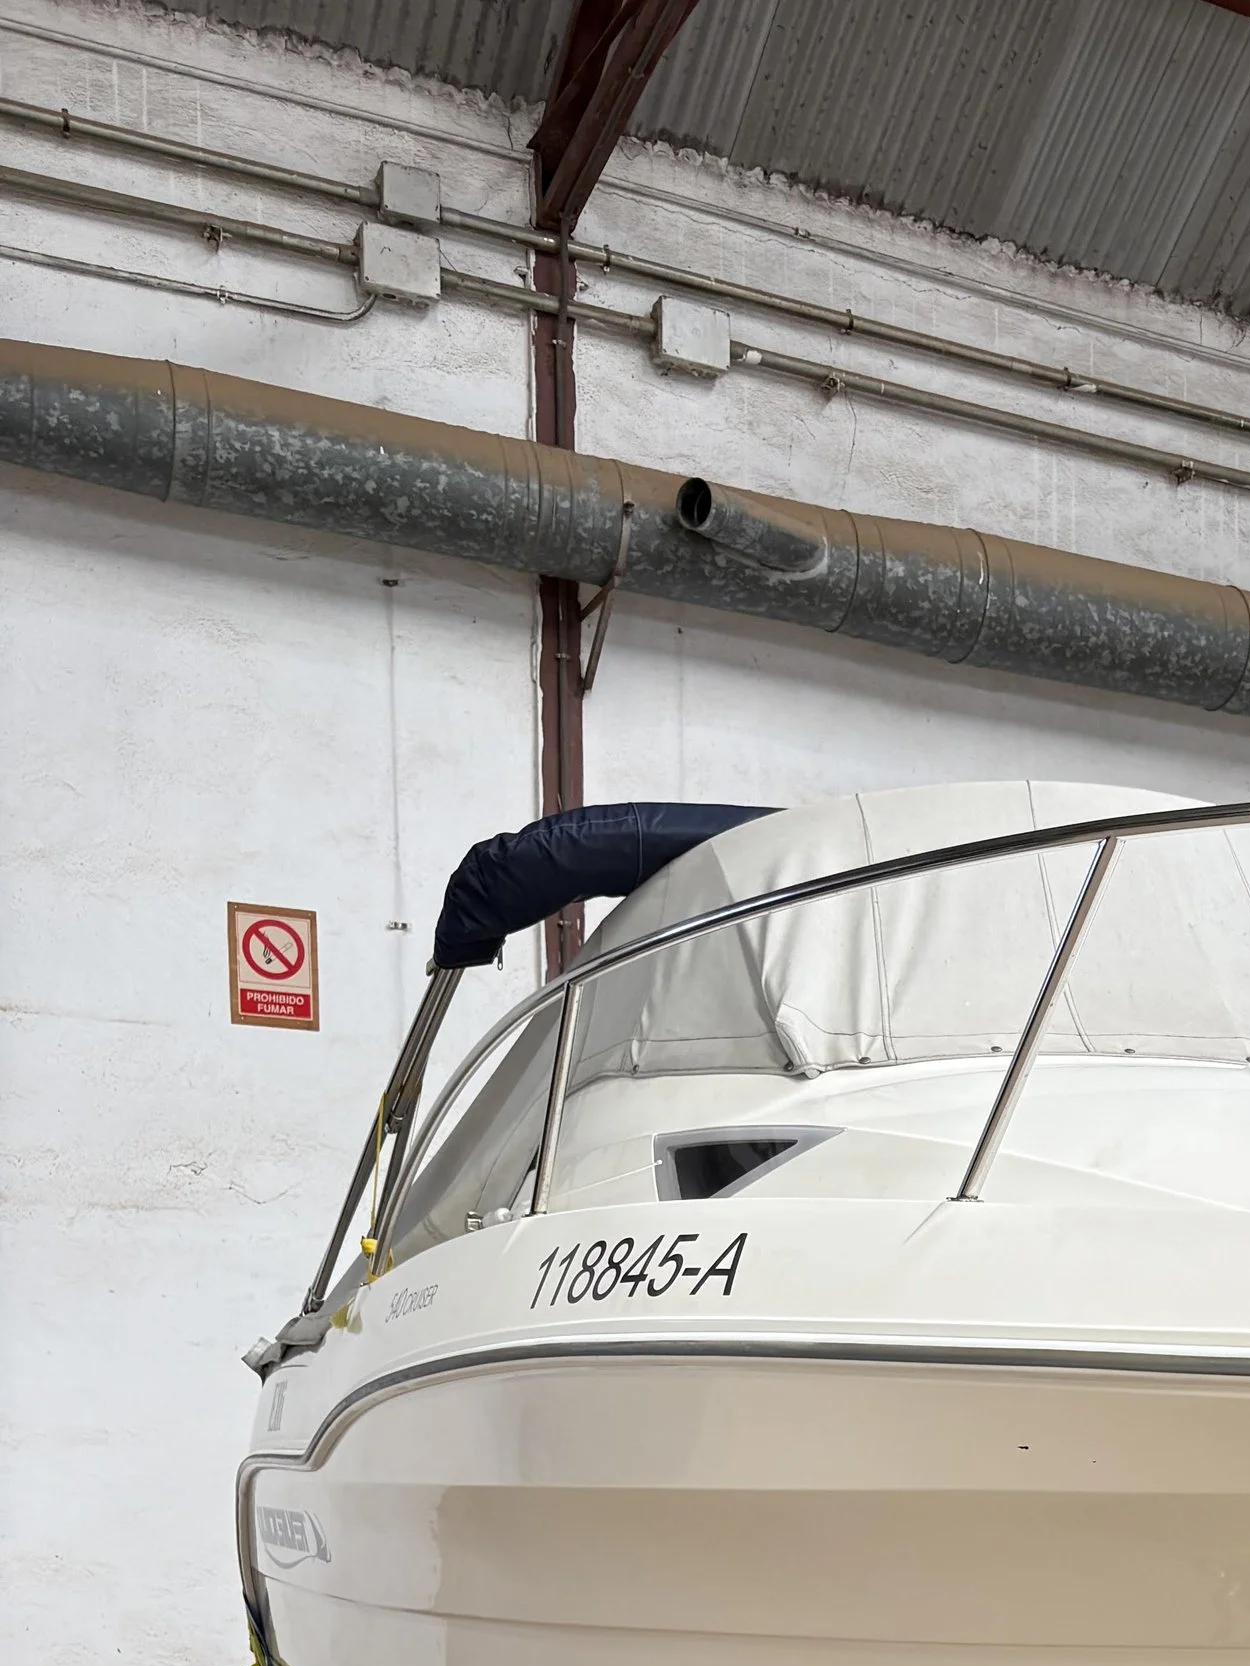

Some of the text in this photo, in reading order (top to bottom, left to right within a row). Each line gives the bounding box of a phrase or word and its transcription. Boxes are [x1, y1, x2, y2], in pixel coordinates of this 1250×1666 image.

[246, 991, 305, 1006] PROHIBIDO
[257, 1004, 294, 1015] FUMAR
[530, 1232, 748, 1310] 118845-A
